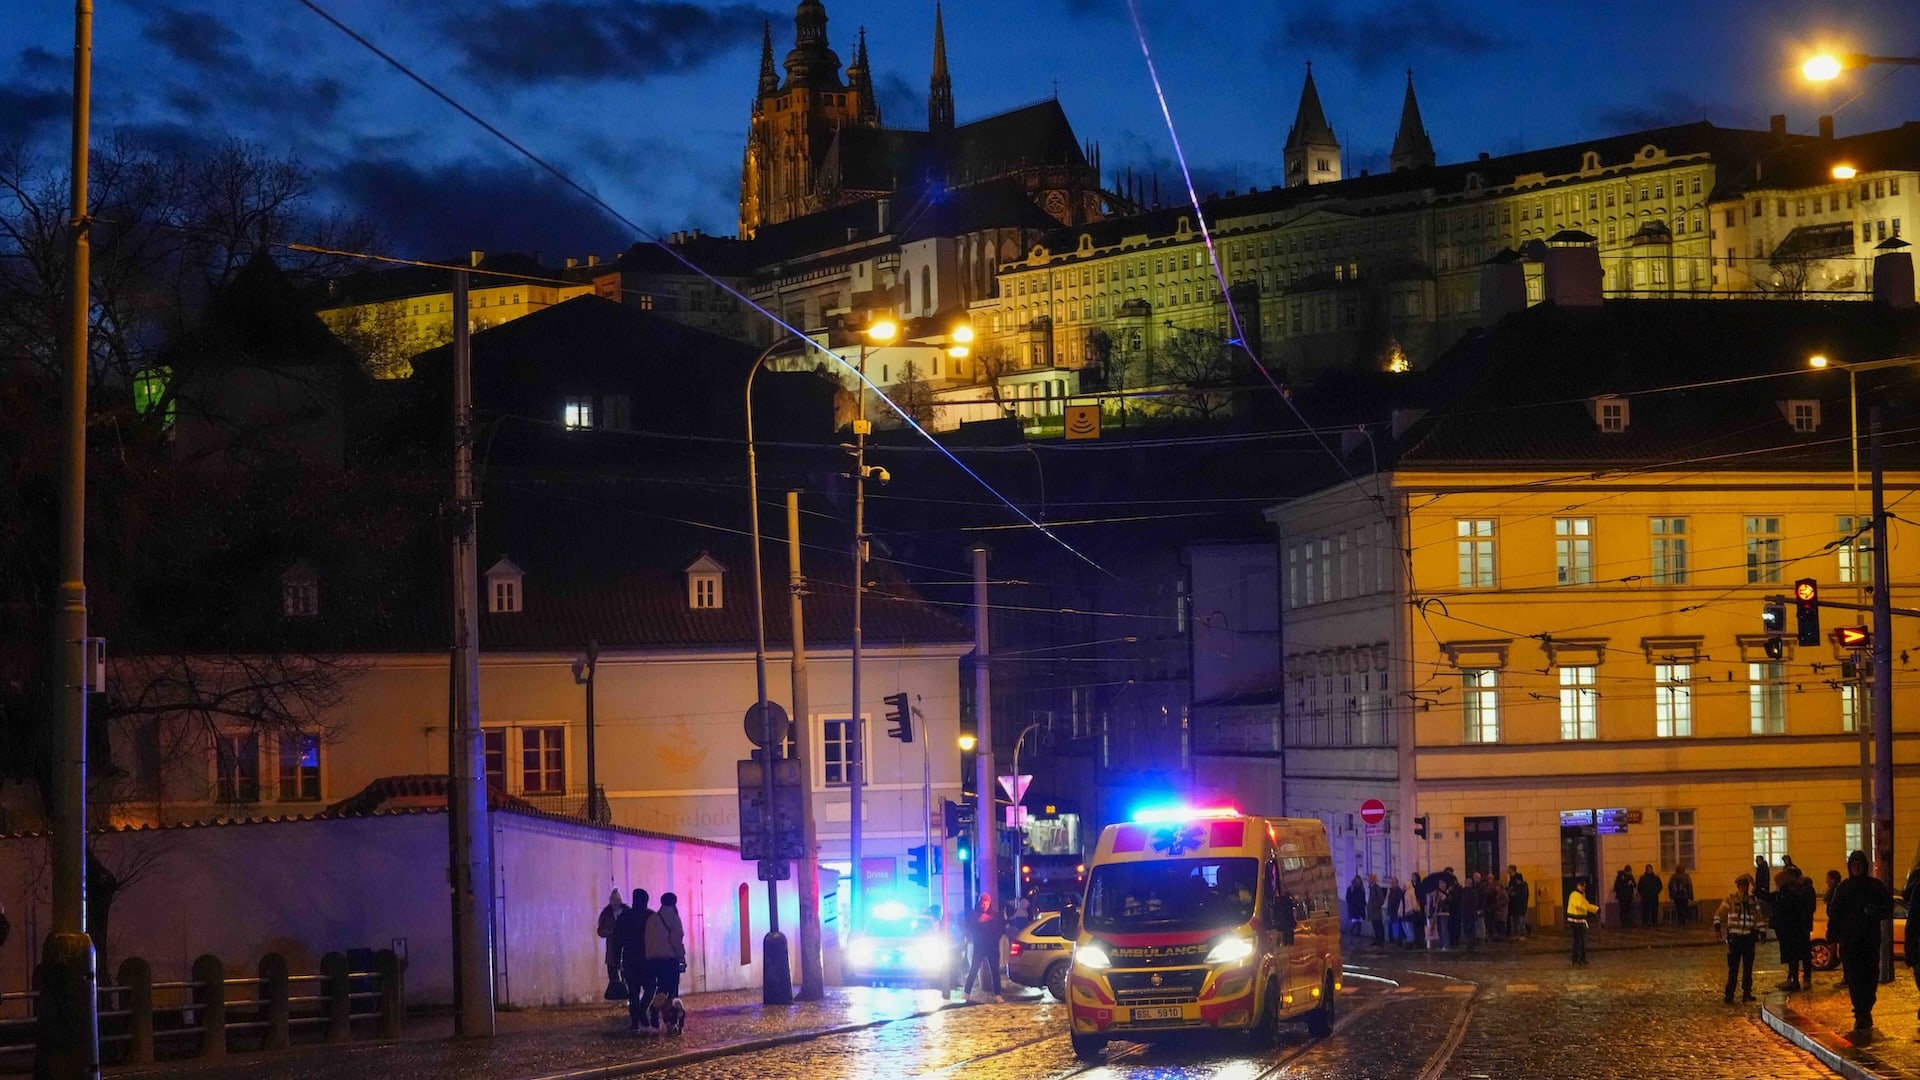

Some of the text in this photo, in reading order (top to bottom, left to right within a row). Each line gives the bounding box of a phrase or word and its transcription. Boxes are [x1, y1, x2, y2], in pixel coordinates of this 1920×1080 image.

[695, 807, 736, 827] lodě
[1110, 944, 1208, 958] AMBULANCE
[1157, 1008, 1178, 1018] 5910
